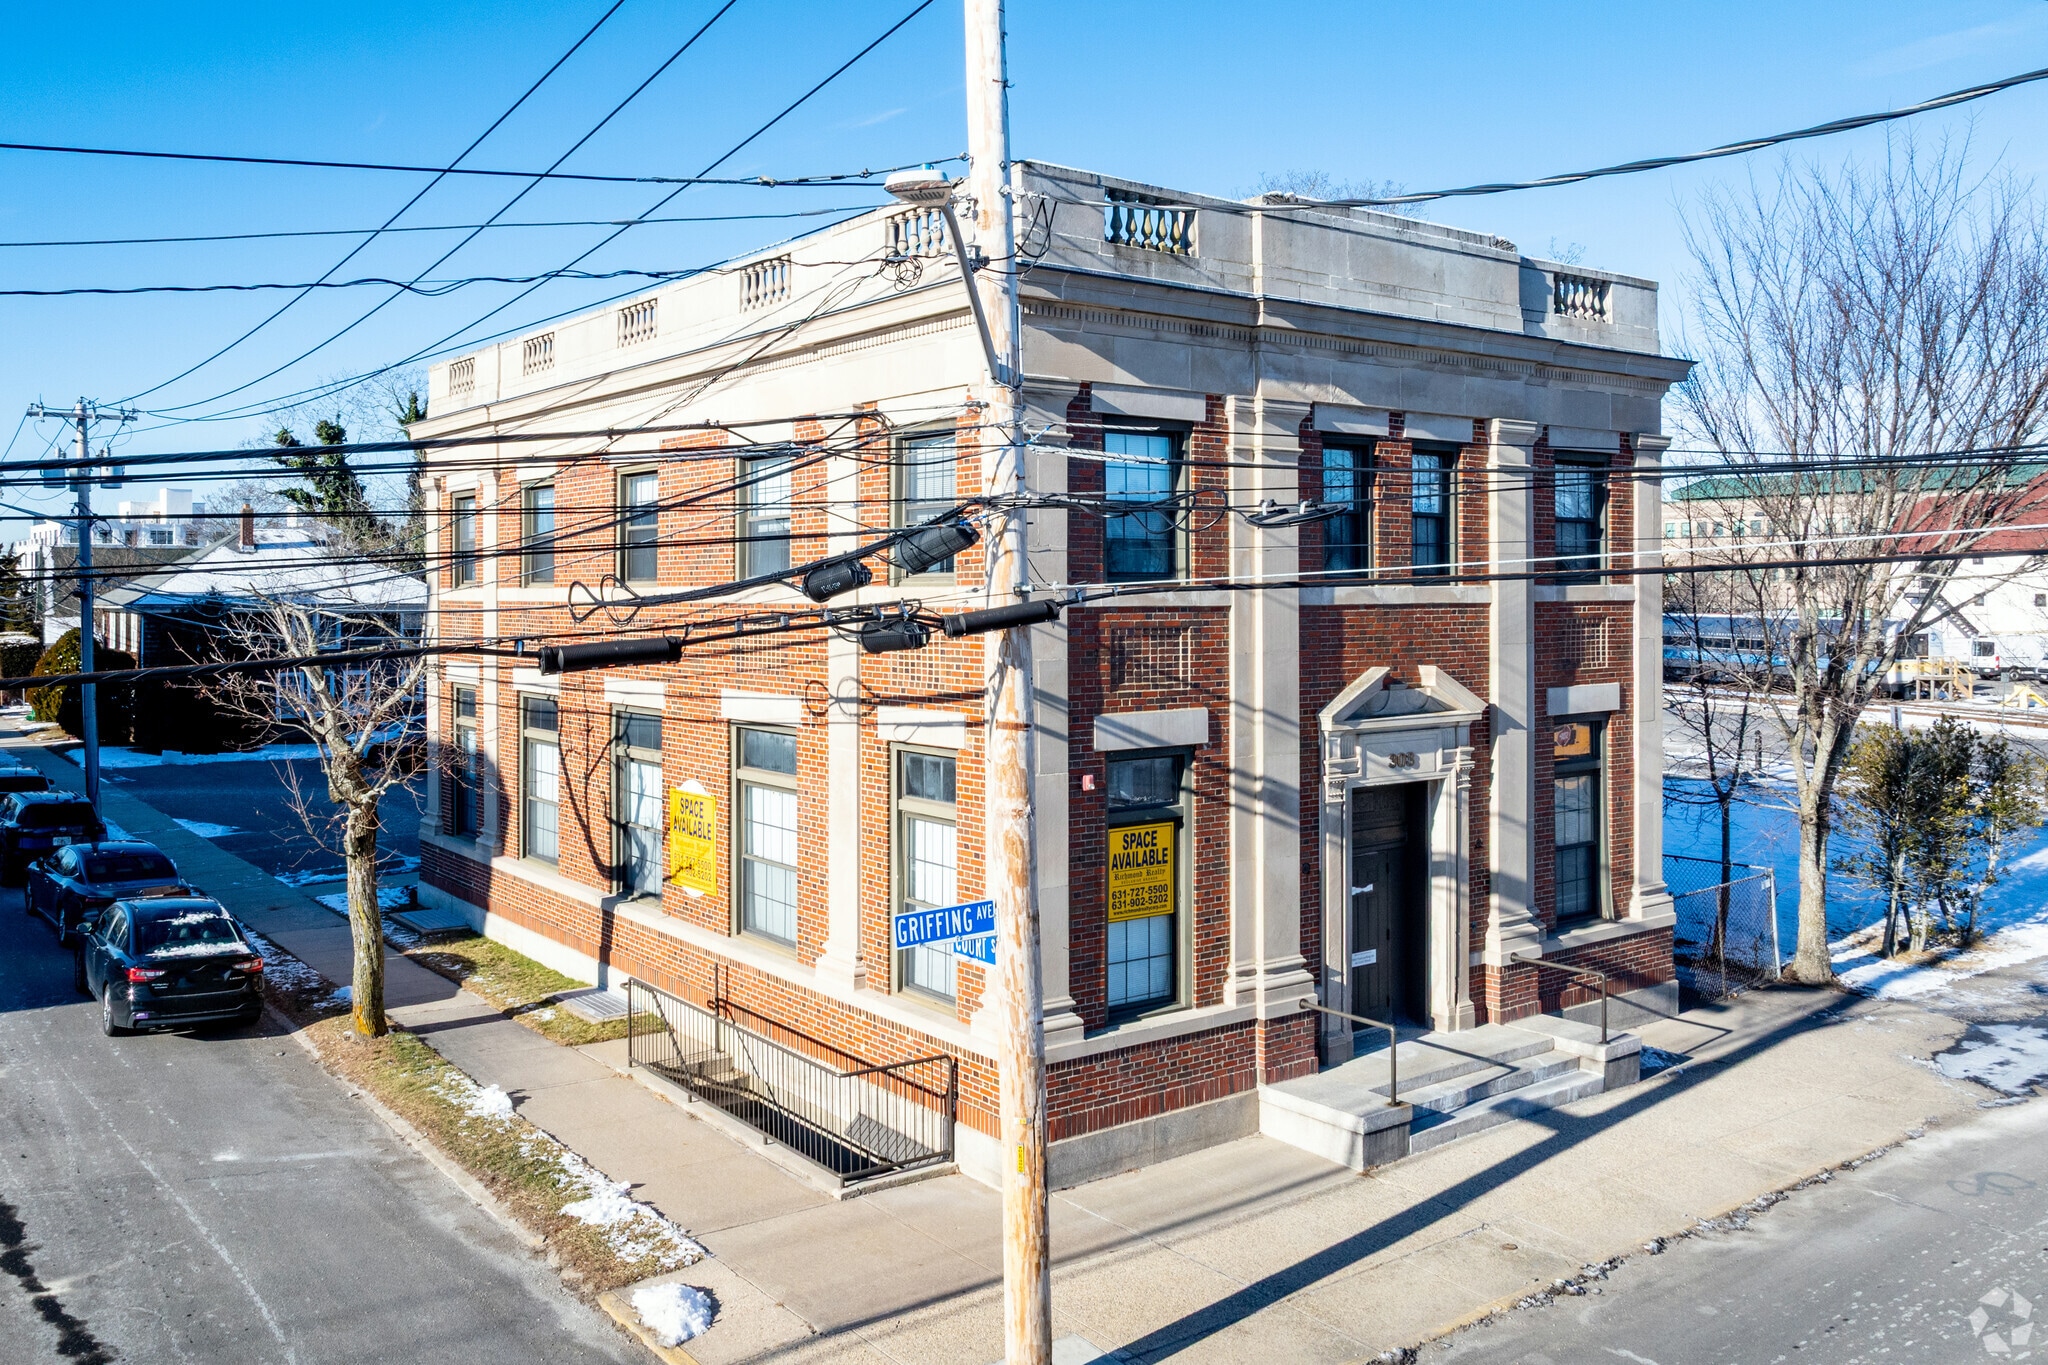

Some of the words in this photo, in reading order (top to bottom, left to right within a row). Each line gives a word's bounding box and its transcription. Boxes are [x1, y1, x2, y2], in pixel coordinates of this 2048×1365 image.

[1388, 751, 1415, 769] 303
[679, 797, 704, 819] SPACE
[673, 815, 712, 841] AVAILABLE
[1122, 830, 1158, 851] SPACE
[1111, 847, 1169, 871] AVAILABLE
[1111, 883, 1168, 900] 631-727-5500
[1111, 893, 1168, 910] 631-902-5202
[897, 907, 973, 944] GRIFFING
[976, 903, 993, 921] AVE
[955, 937, 987, 959] COURT
[990, 938, 996, 954] S
